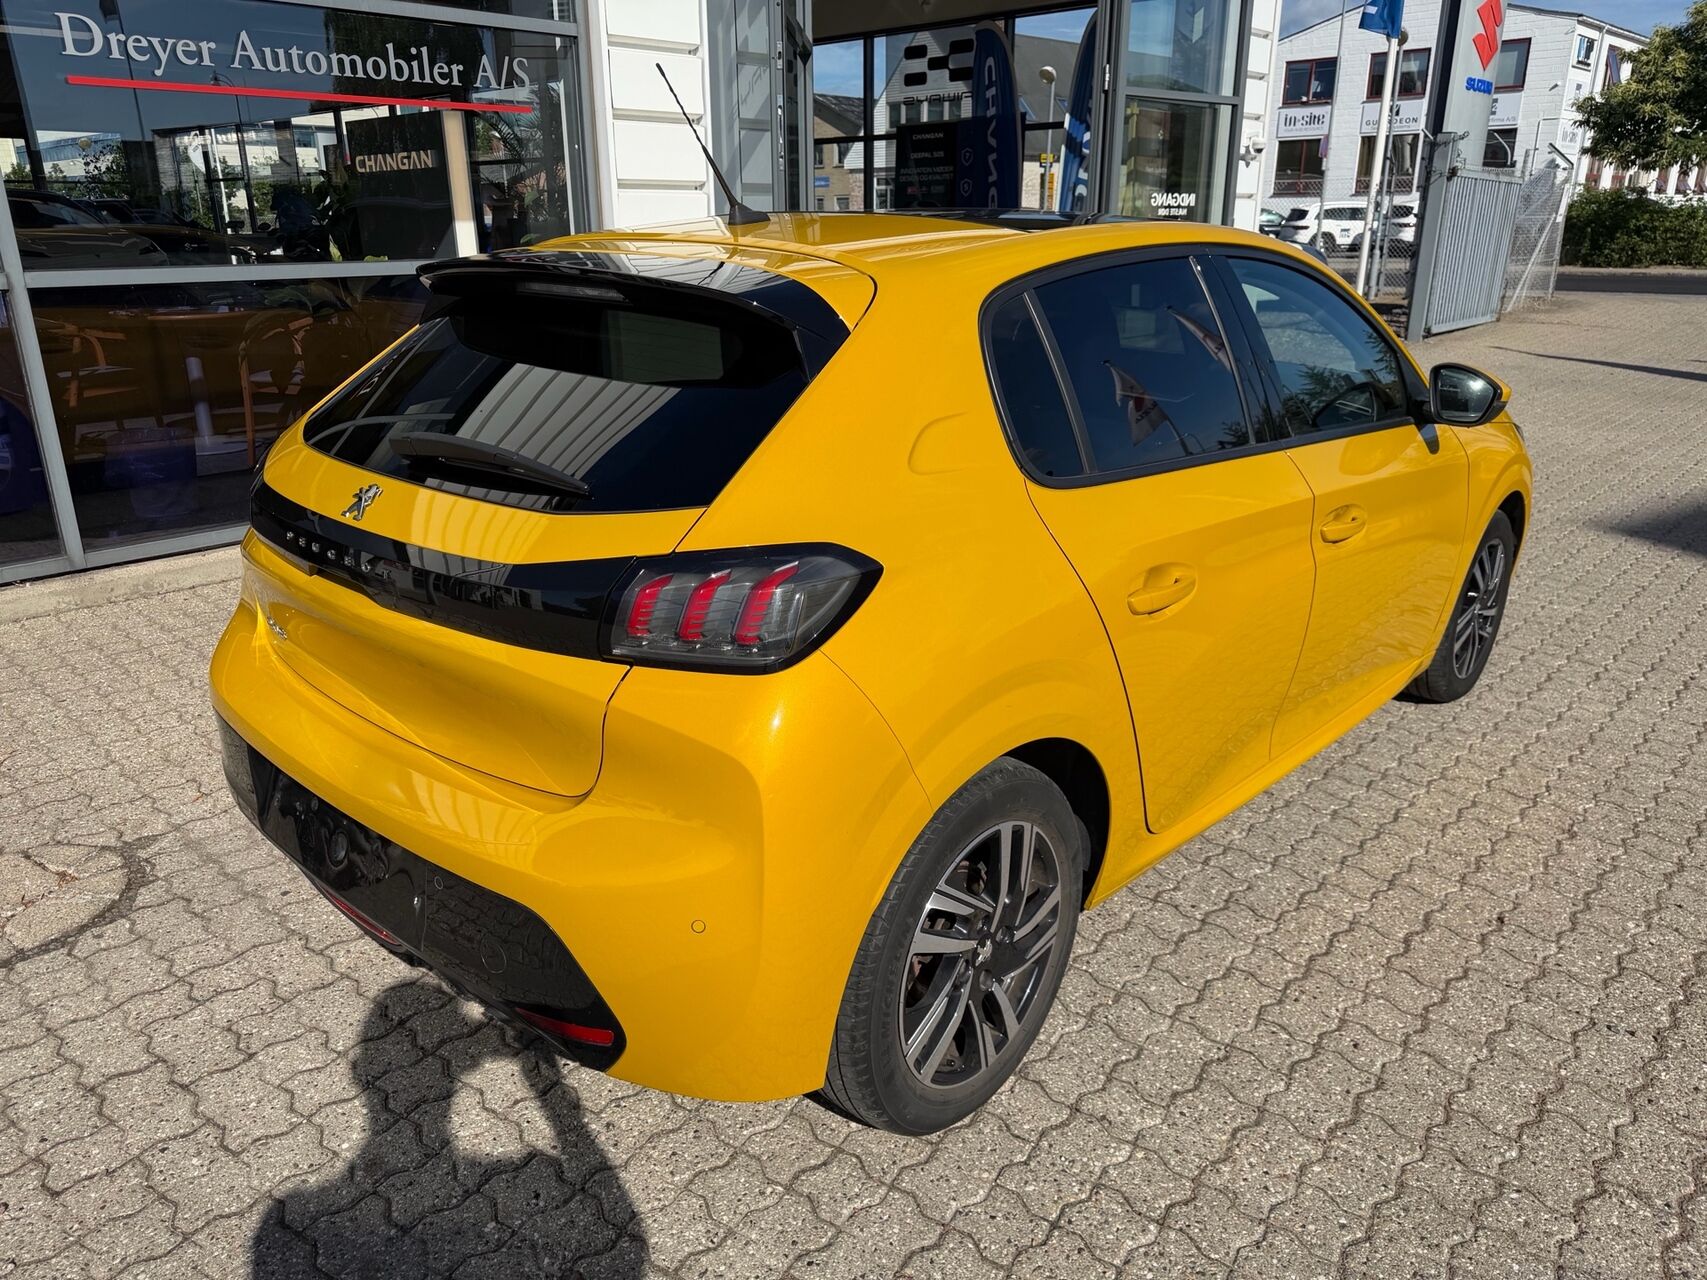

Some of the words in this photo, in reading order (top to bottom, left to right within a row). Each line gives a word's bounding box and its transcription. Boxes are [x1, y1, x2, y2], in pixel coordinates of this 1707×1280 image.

[54, 12, 216, 77] Dreyer
[230, 30, 464, 87] Automobiler
[473, 54, 530, 90] A/S
[1365, 117, 1419, 126] GUDEON
[355, 149, 433, 173] CHANGAN
